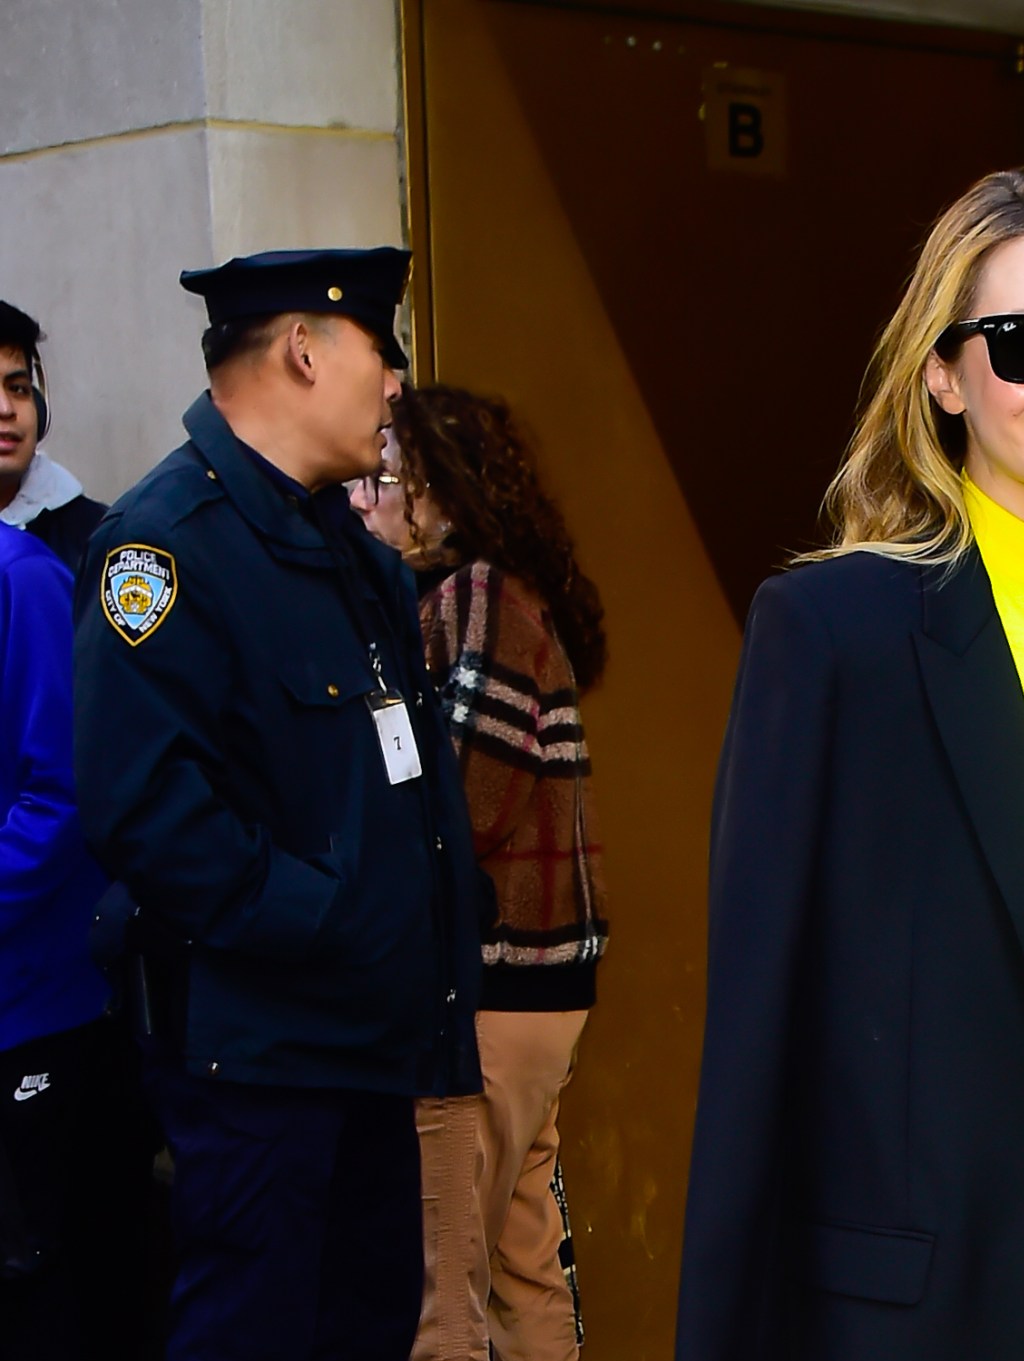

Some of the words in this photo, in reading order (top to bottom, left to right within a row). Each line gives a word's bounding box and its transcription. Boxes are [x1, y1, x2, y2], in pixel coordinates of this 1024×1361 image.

[728, 102, 765, 158] B
[120, 549, 156, 561] POLICE
[108, 561, 170, 580] DEPARTMENT
[105, 590, 117, 612] CITY
[113, 613, 126, 626] OF
[139, 613, 158, 633] NEW
[155, 586, 172, 612] YORK
[393, 735, 402, 751] 7
[20, 1072, 50, 1091] NIKE
